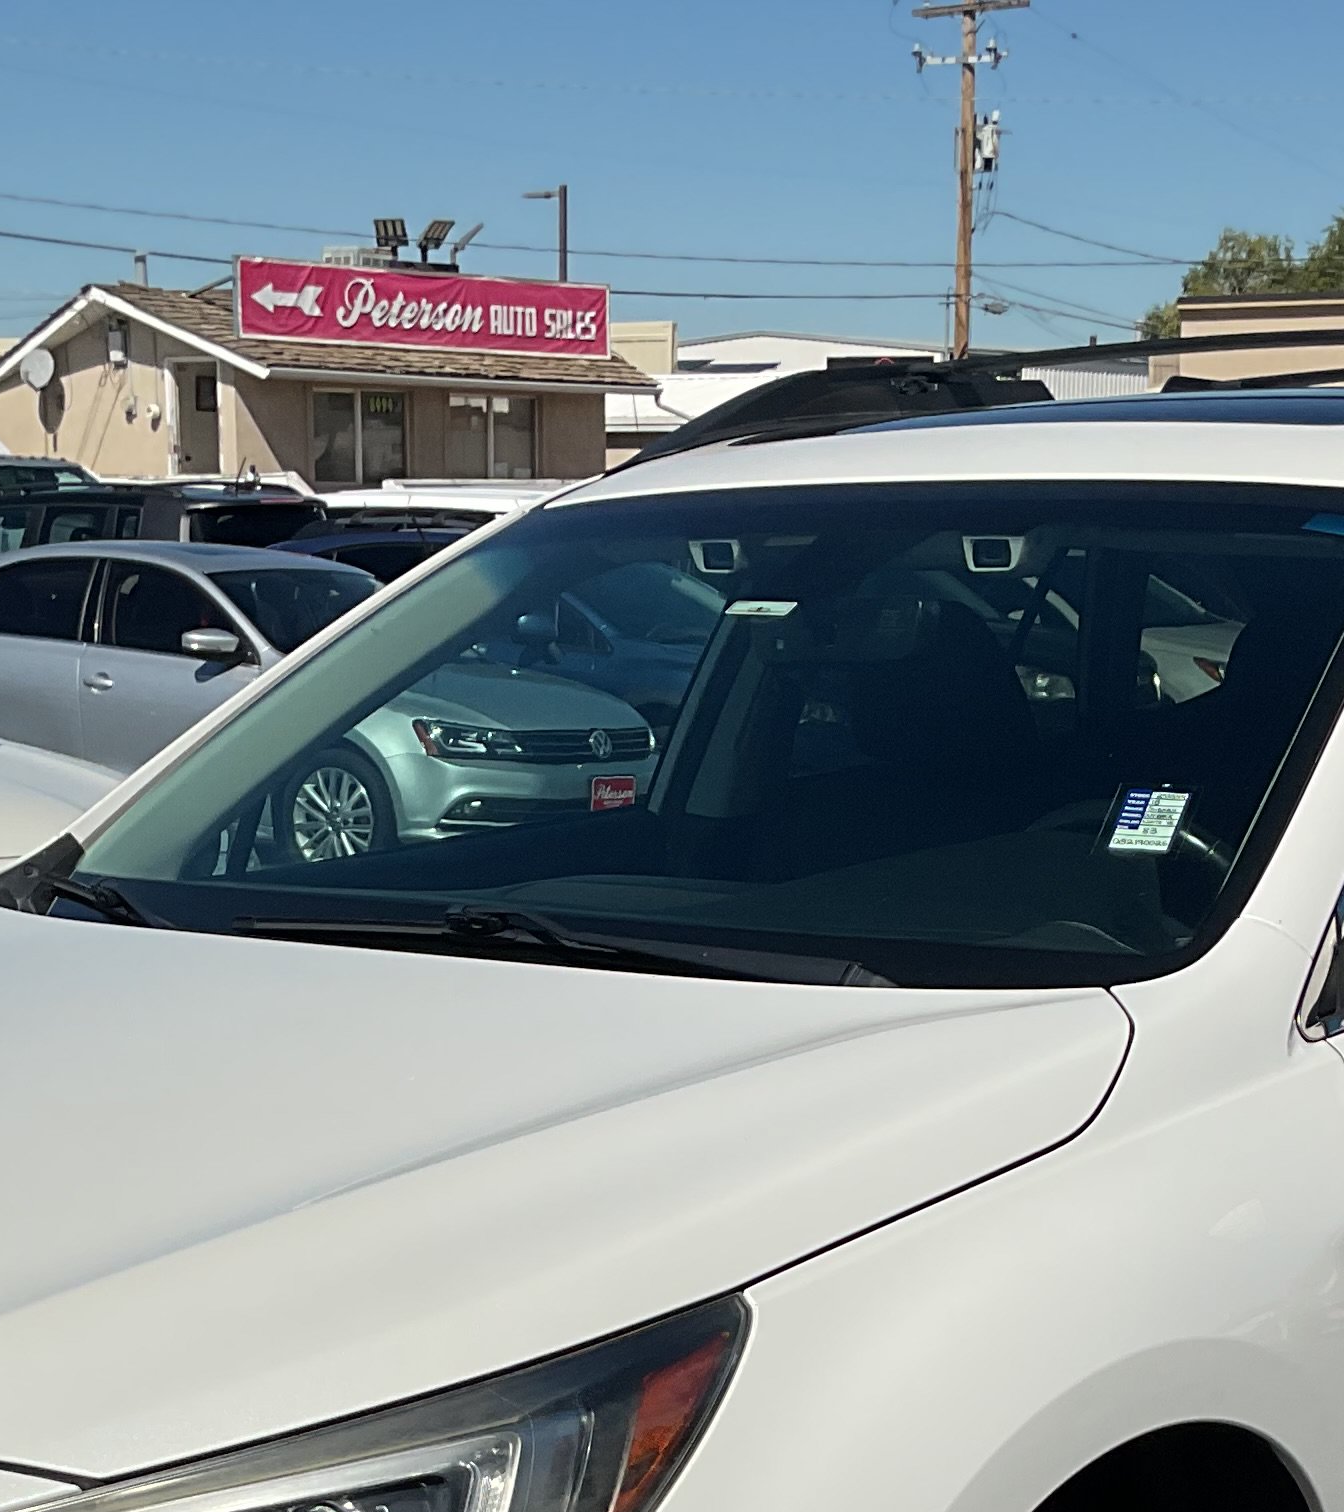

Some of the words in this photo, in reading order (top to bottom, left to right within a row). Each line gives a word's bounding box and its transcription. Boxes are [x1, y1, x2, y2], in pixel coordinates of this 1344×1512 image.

[335, 277, 485, 334] Peterson
[489, 303, 538, 338] AUTO
[544, 308, 598, 341] SALES
